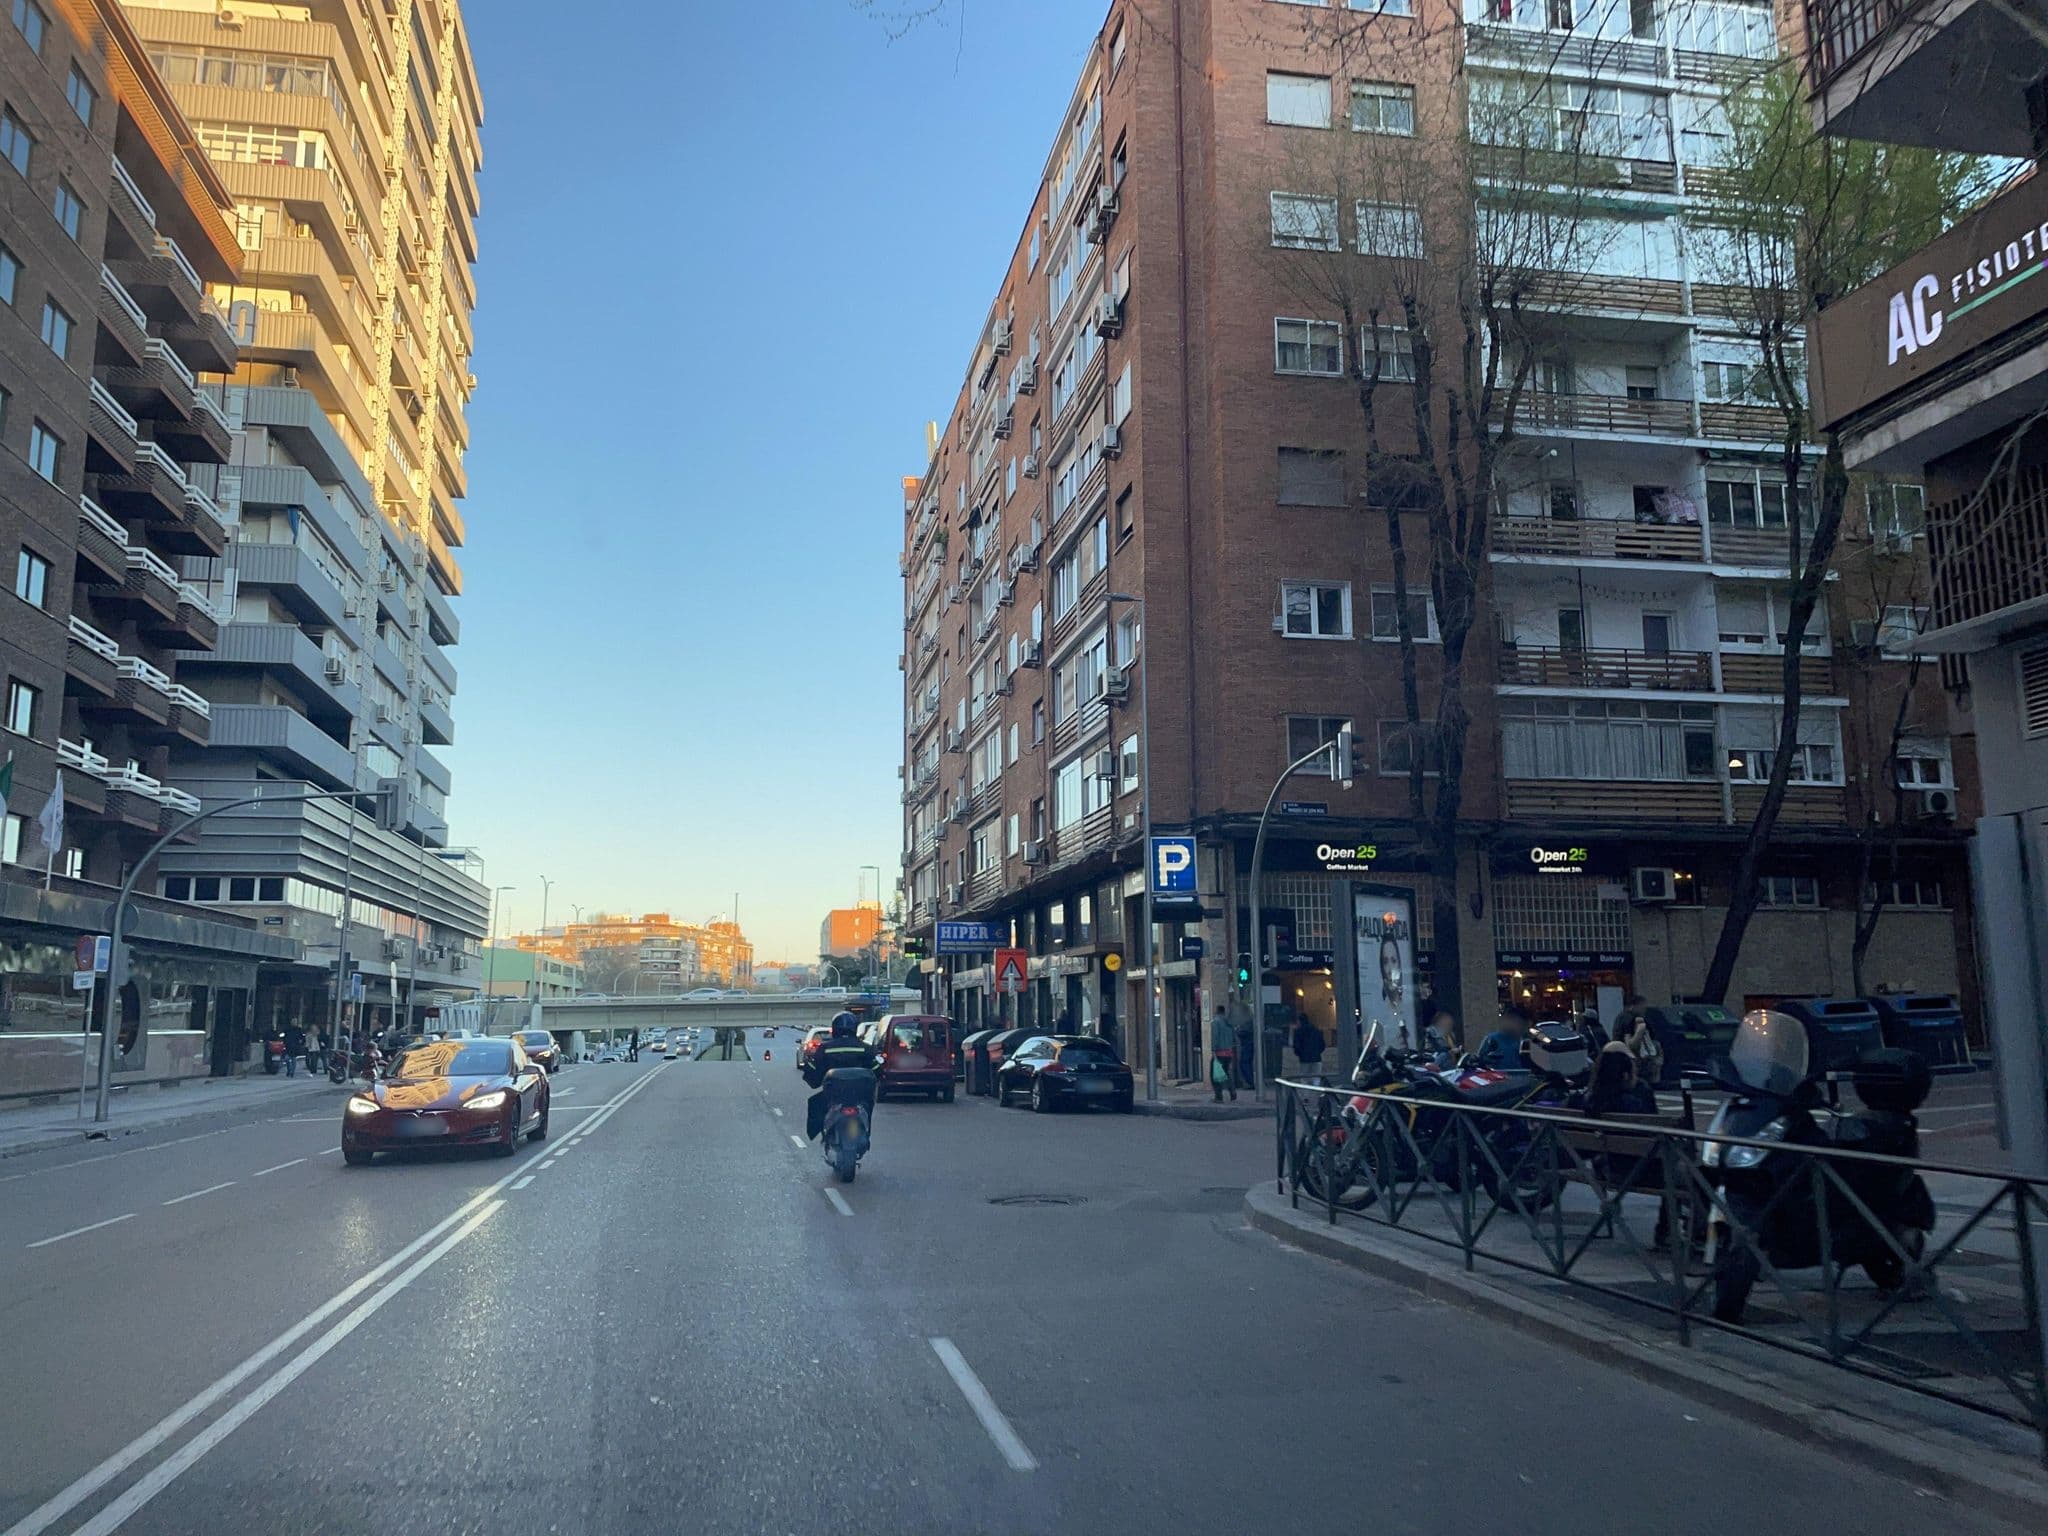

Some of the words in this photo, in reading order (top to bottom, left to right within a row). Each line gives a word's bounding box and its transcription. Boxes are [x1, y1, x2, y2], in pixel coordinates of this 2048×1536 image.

[1888, 273, 1943, 366] AC
[1316, 844, 1355, 860] Open
[1356, 845, 1377, 859] 25
[1530, 847, 1567, 863] Open
[1568, 848, 1588, 861] 25
[1158, 844, 1191, 887] P
[940, 926, 989, 939] HIPER
